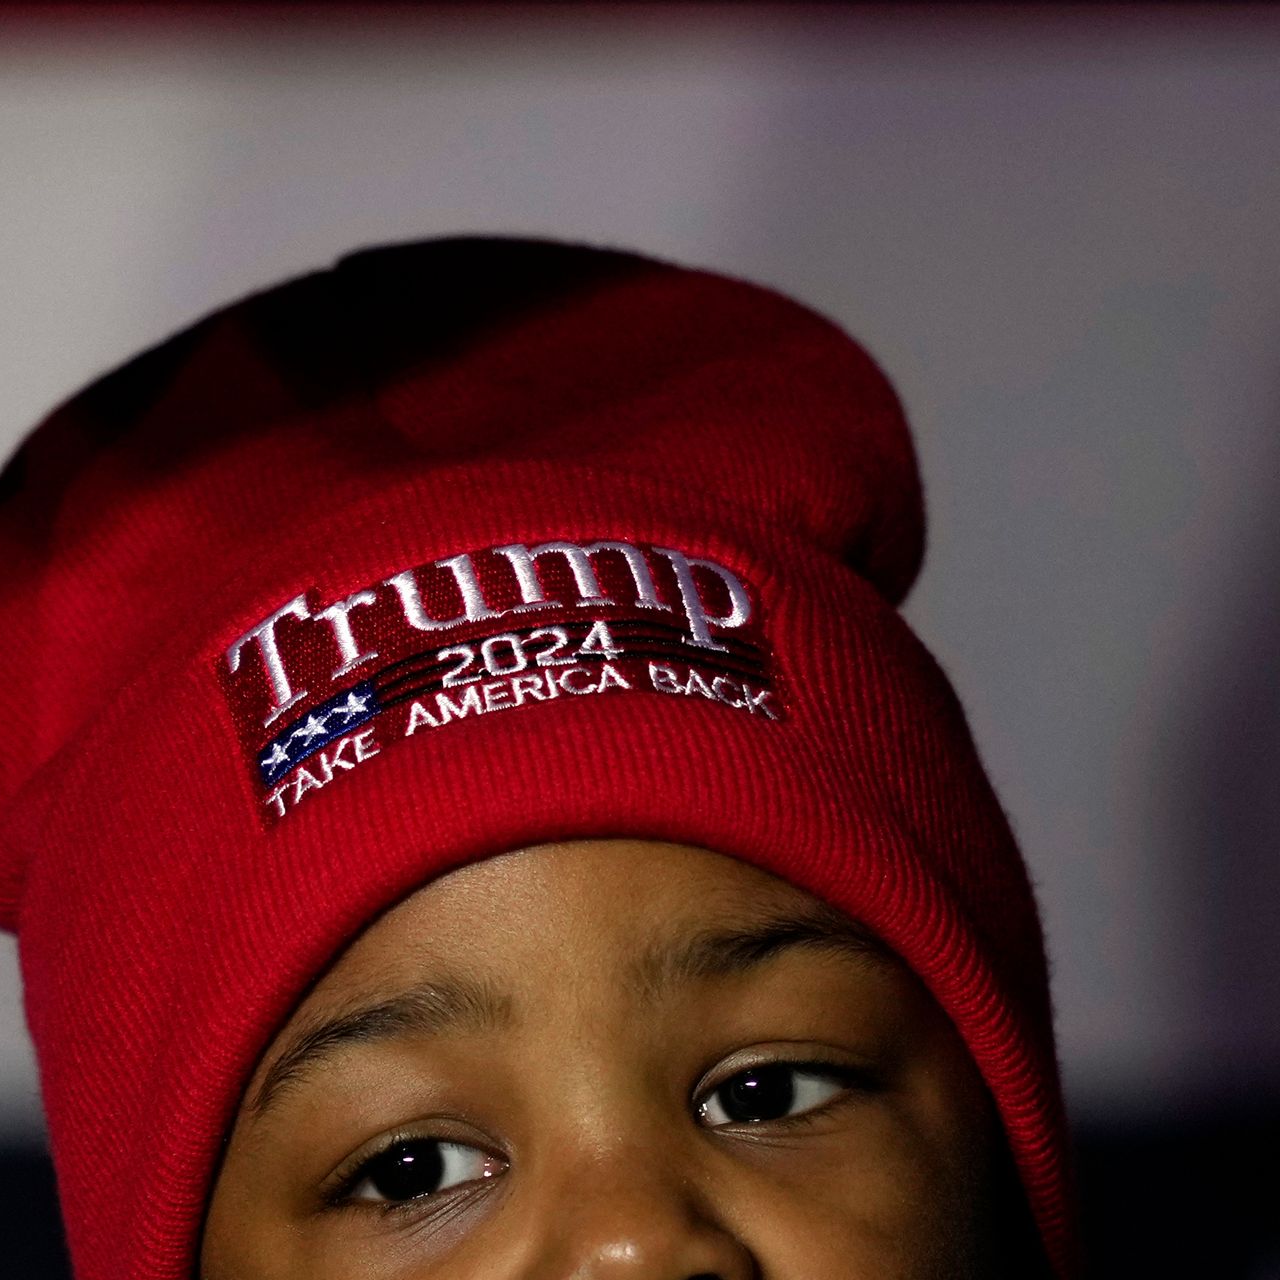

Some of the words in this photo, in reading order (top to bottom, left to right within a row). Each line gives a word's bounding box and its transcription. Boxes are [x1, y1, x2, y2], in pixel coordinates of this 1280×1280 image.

[227, 540, 751, 728] Trump
[437, 619, 624, 688] 2024
[265, 727, 381, 817] TAKE
[405, 664, 632, 737] AMERICA
[648, 662, 779, 720] BACK
